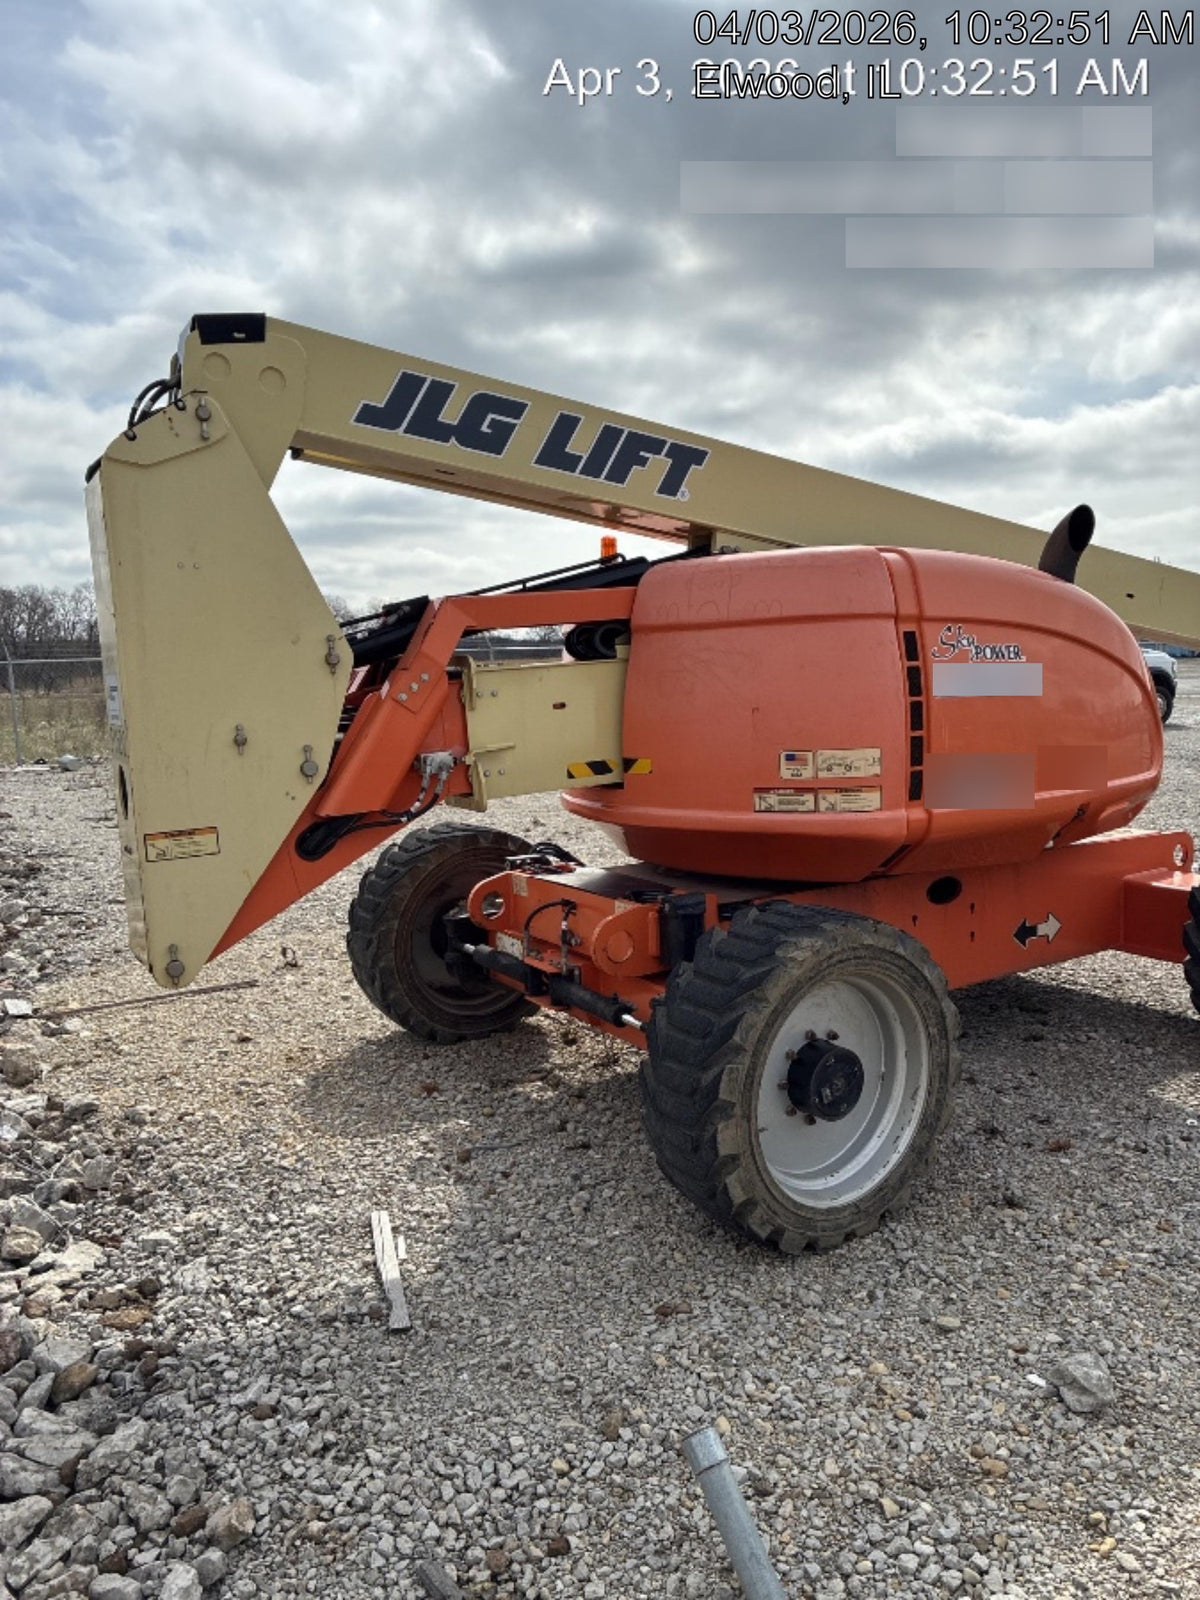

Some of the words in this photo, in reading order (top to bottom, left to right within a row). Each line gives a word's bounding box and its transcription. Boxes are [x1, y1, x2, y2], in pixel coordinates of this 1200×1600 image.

[351, 369, 532, 457] JLG
[931, 624, 977, 662] Sky
[973, 643, 1026, 662] POWER
